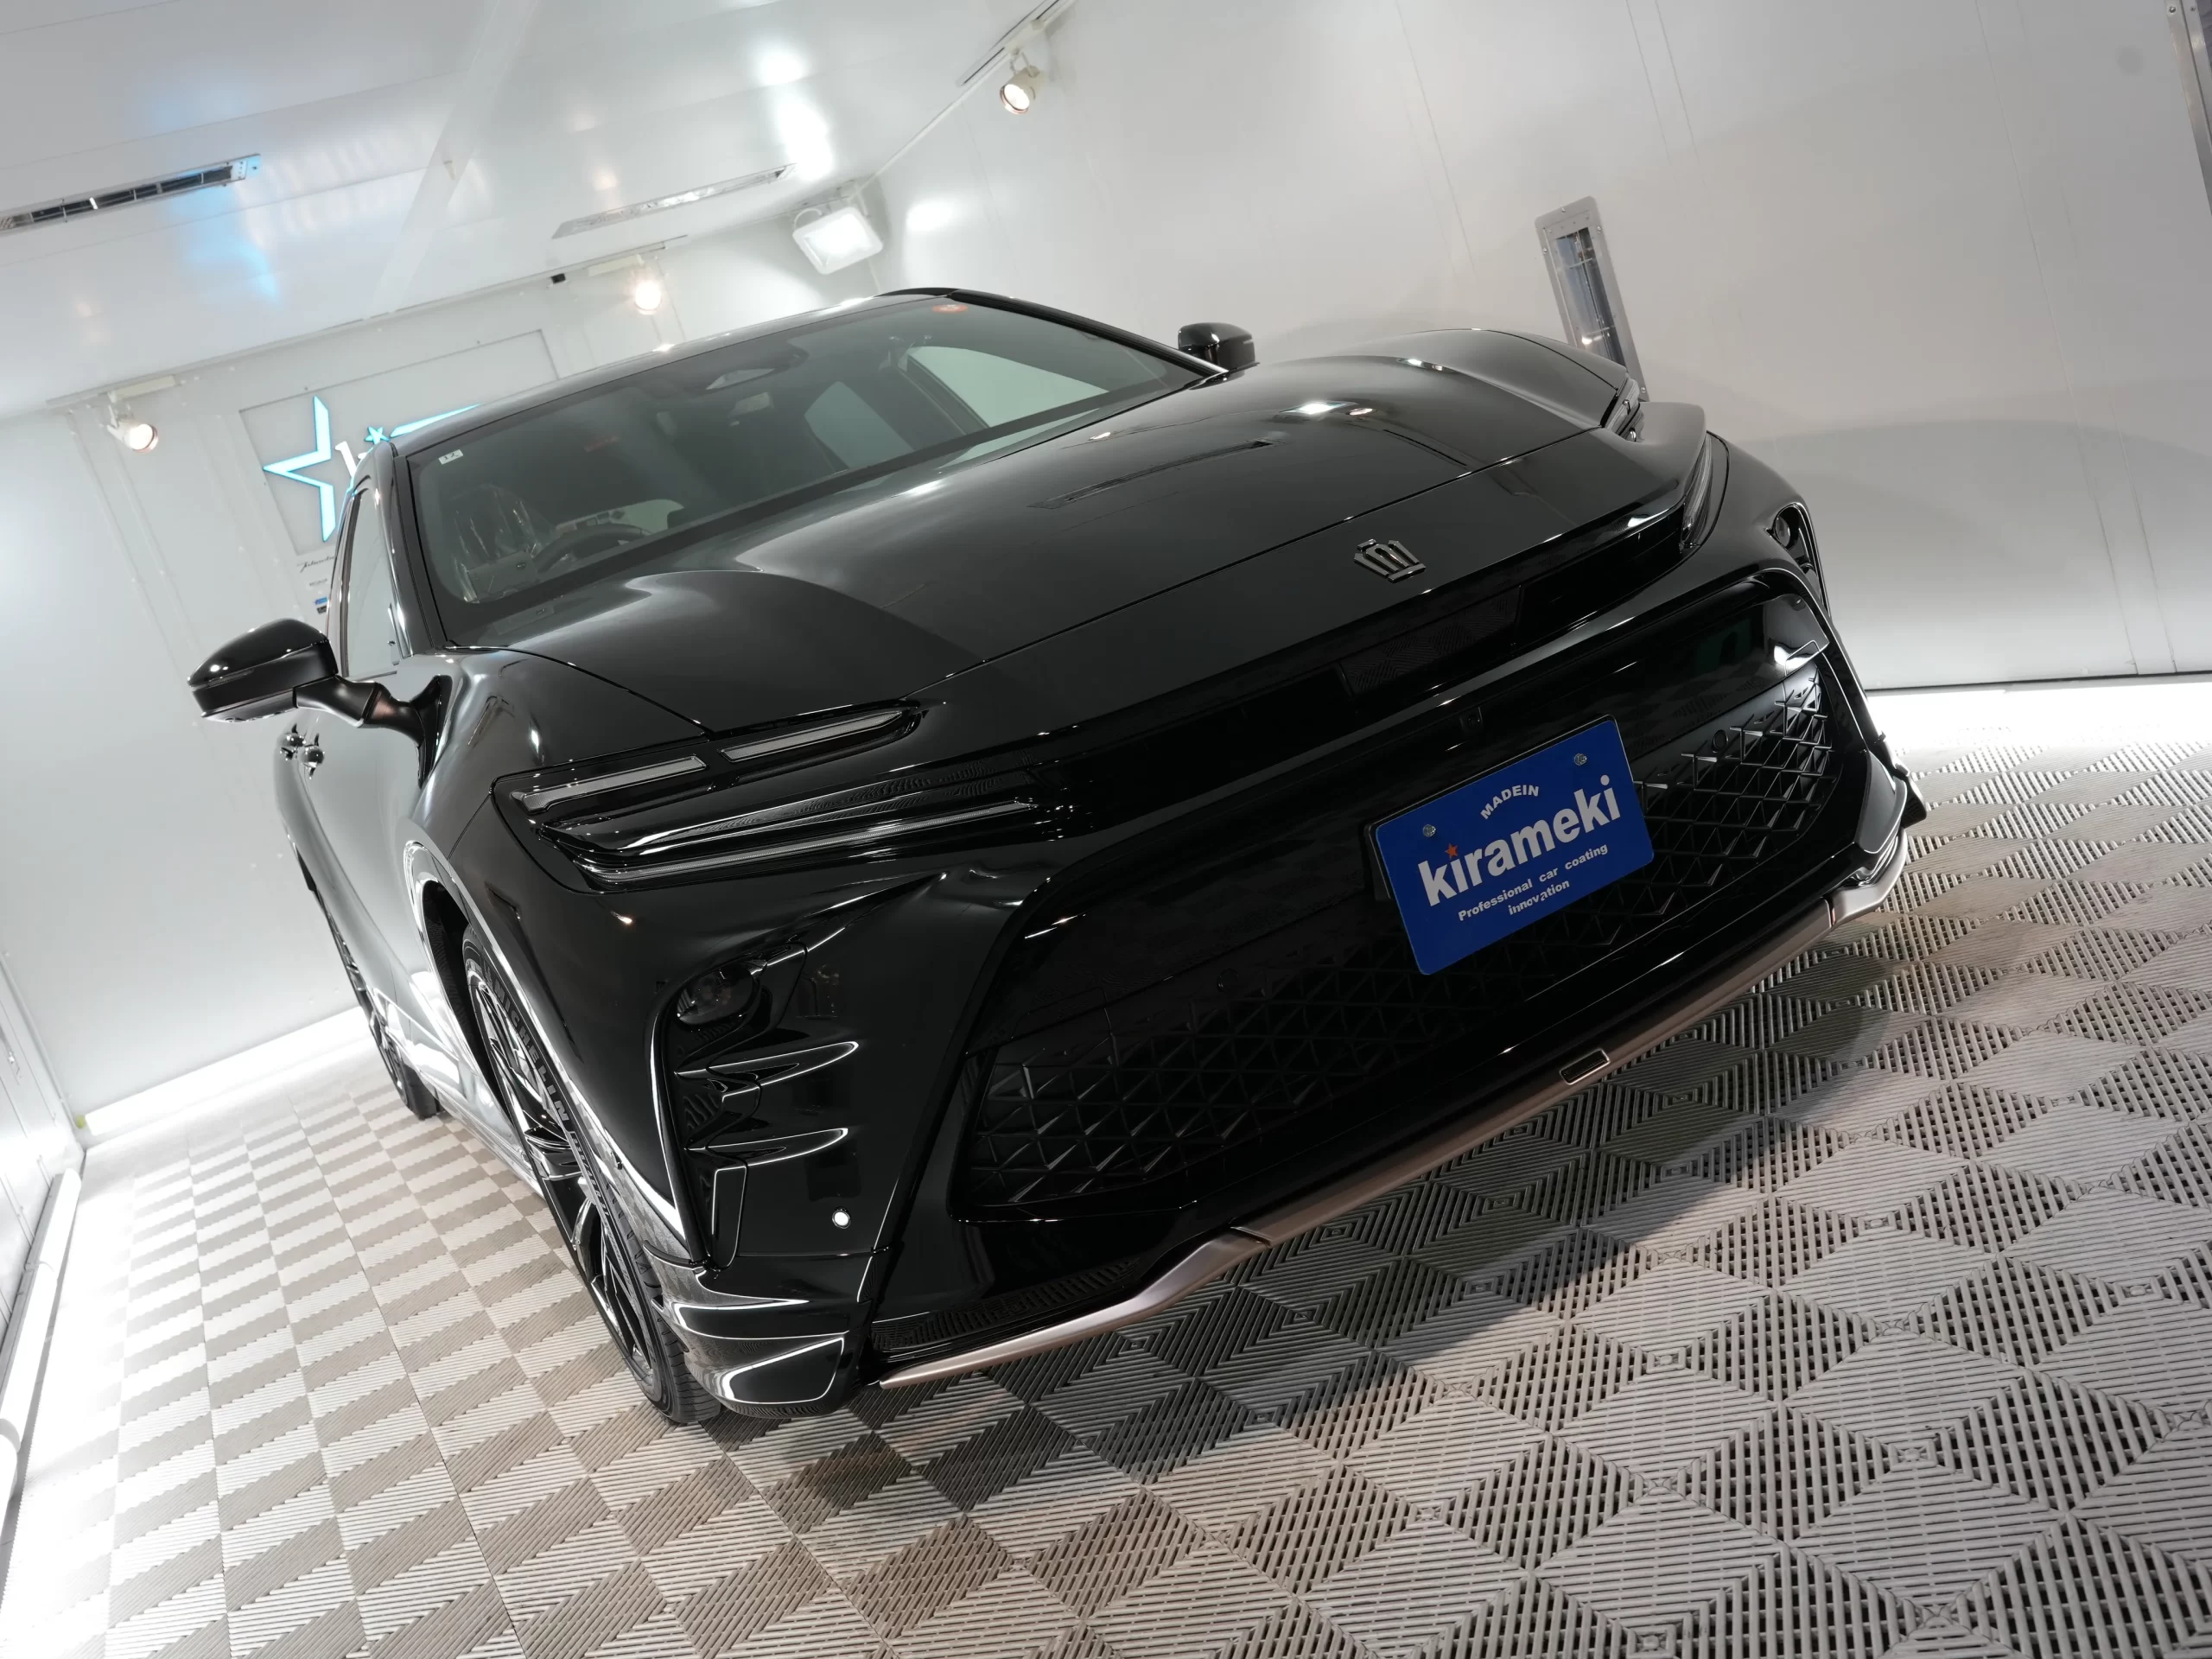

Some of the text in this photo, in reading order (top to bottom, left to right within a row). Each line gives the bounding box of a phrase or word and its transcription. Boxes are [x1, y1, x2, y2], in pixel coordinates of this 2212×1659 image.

[1417, 774, 1621, 907] kirameki
[1458, 843, 1609, 922] Professional car coating
[1508, 880, 1571, 916] innovation
[493, 978, 570, 1122] MICHELIN
